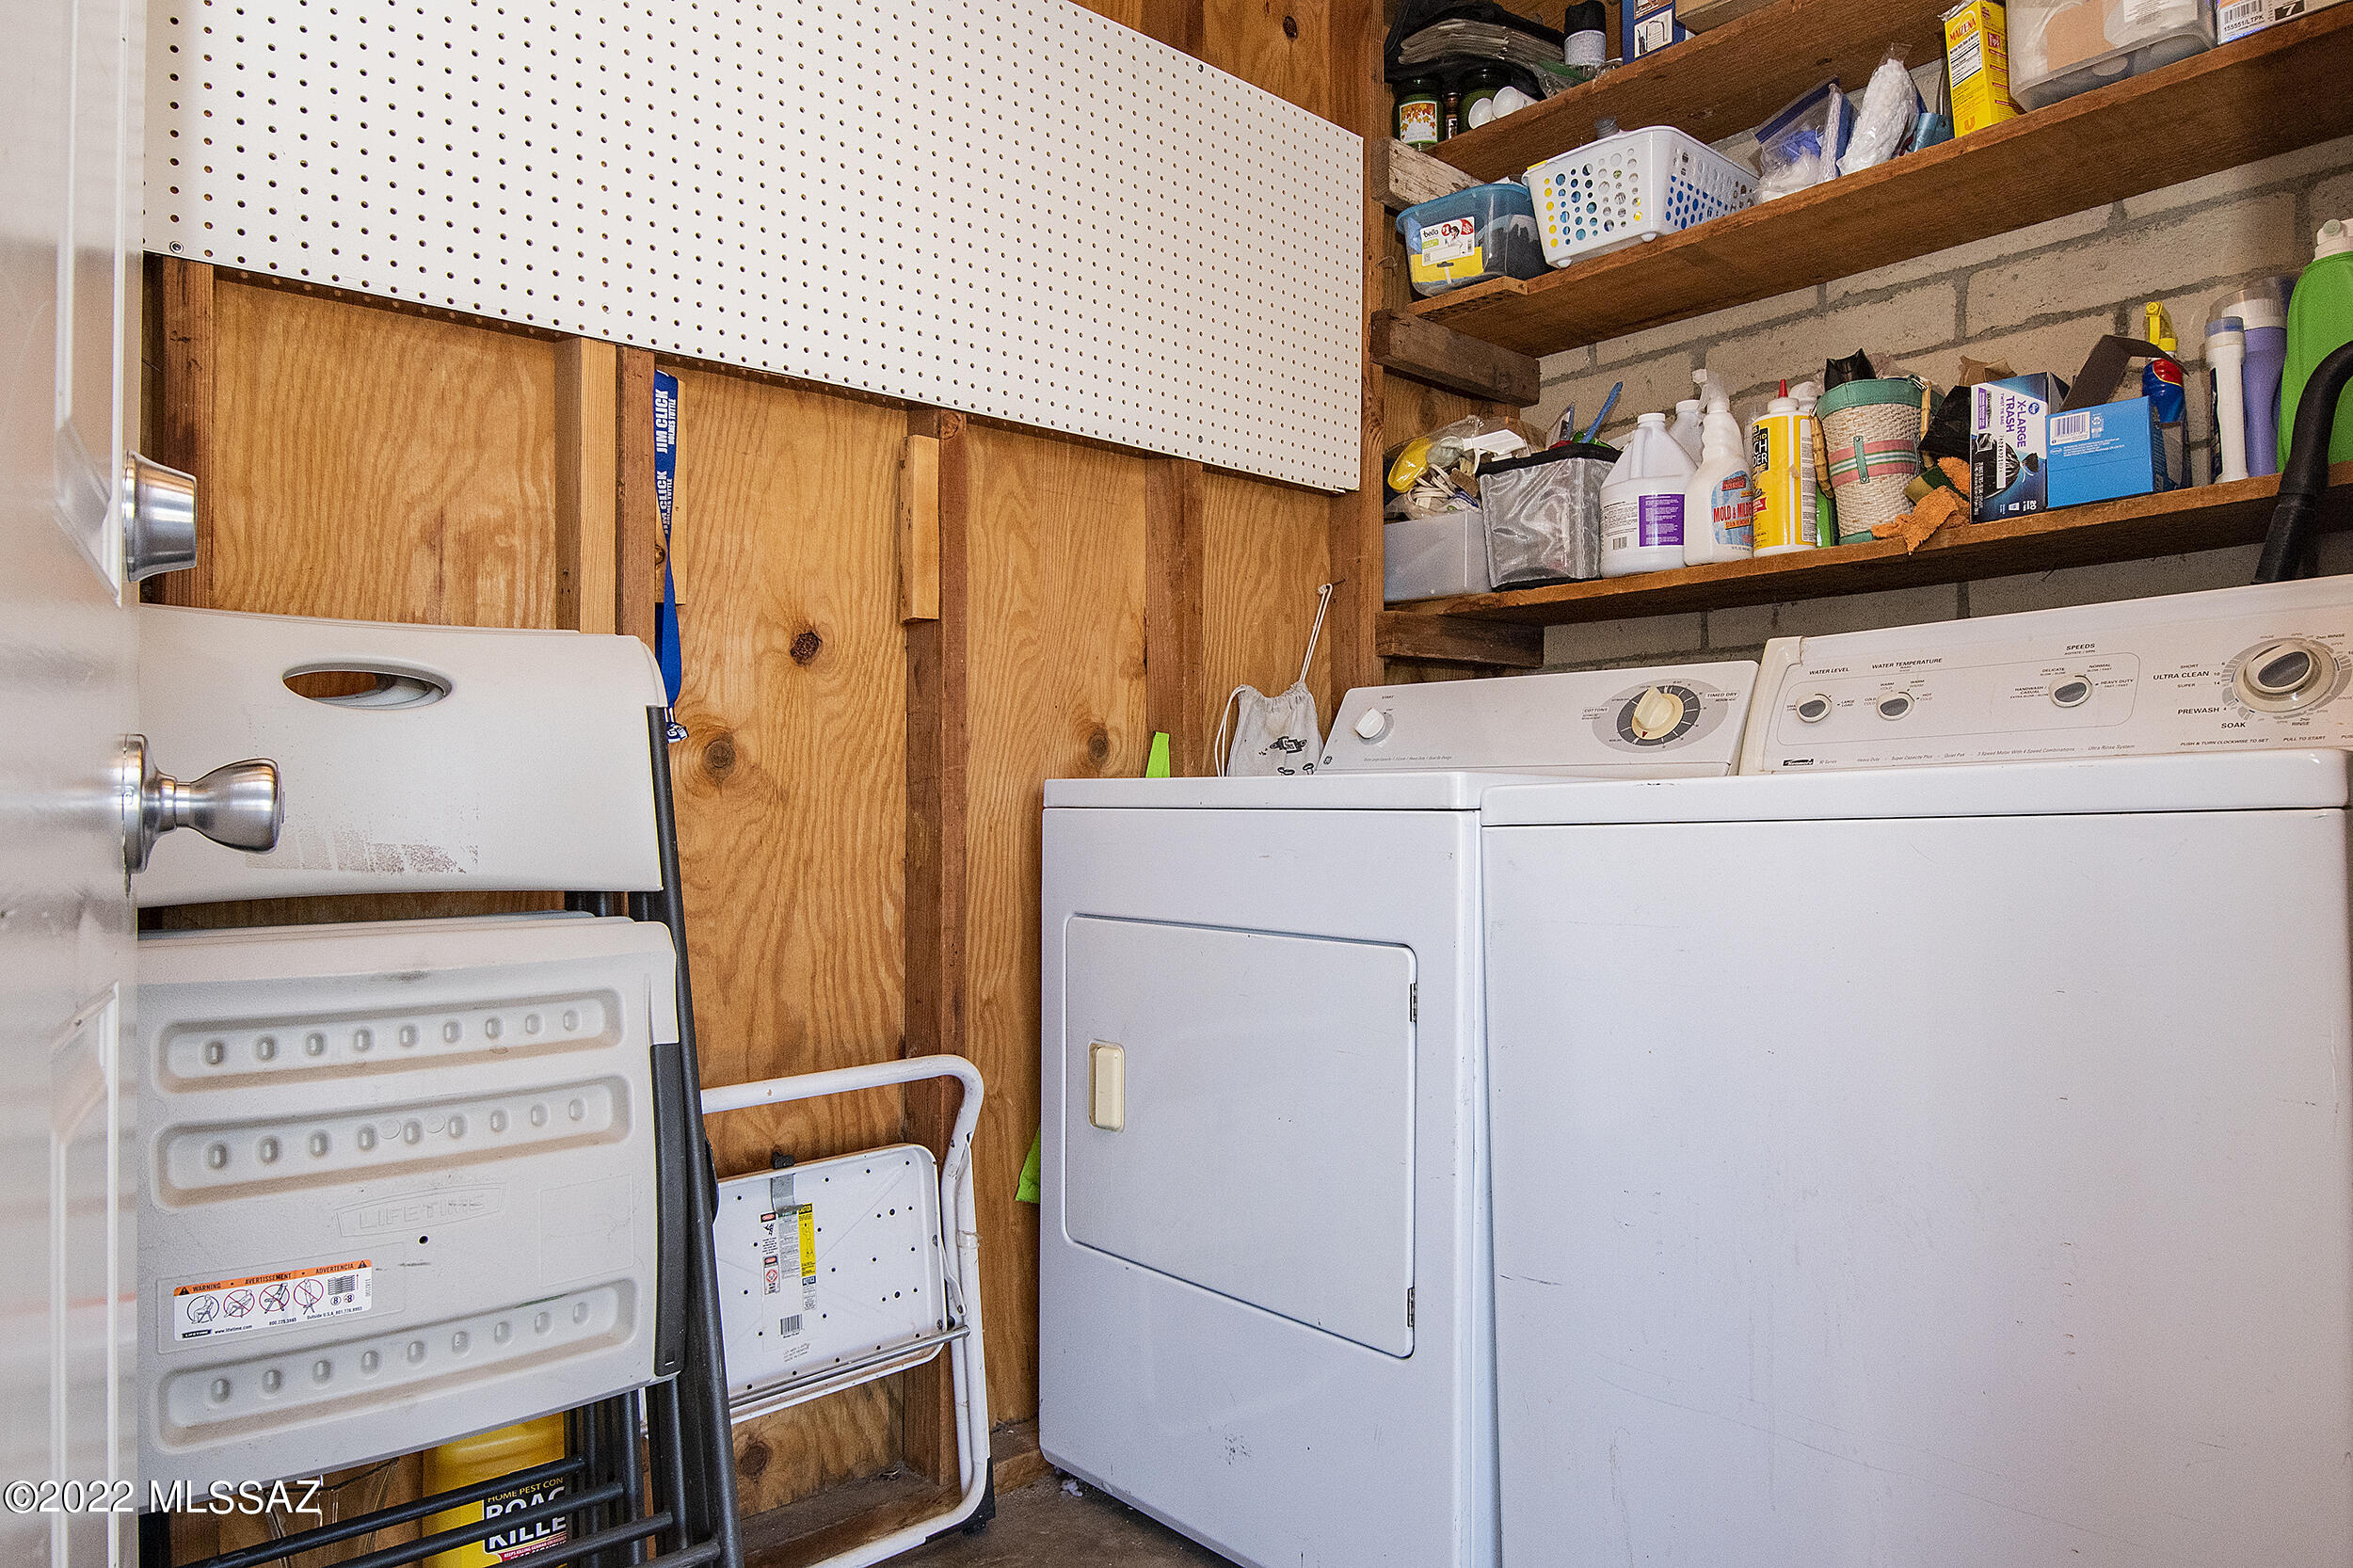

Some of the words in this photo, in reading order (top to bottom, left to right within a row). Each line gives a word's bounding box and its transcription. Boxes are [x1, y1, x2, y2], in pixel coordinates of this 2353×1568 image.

[2282, 3, 2297, 16] 7
[1949, 18, 1977, 42] MAIZENA
[655, 389, 668, 429] CLICK
[2006, 395, 2015, 433] TRASH
[667, 421, 676, 445] HOLMES
[2017, 400, 2026, 449] X-LARGE
[656, 430, 668, 454] JIM
[657, 471, 668, 510] CLICK
[1713, 504, 1732, 523] MOLD
[1733, 507, 1737, 520] &
[2029, 500, 2037, 510] 20
[2066, 643, 2095, 651] SPEEDS
[1896, 658, 1943, 667] TEMPERATURE
[2177, 707, 2220, 715] PREWASH
[359, 1194, 484, 1229] LIFETIME
[192, 1282, 221, 1292] WARNING
[245, 1272, 292, 1285] AVERTISSEMENT
[315, 1263, 354, 1274] ADVERTENCIA
[488, 1490, 518, 1503] HOME
[520, 1483, 541, 1496] PEST
[543, 1477, 564, 1489] CON
